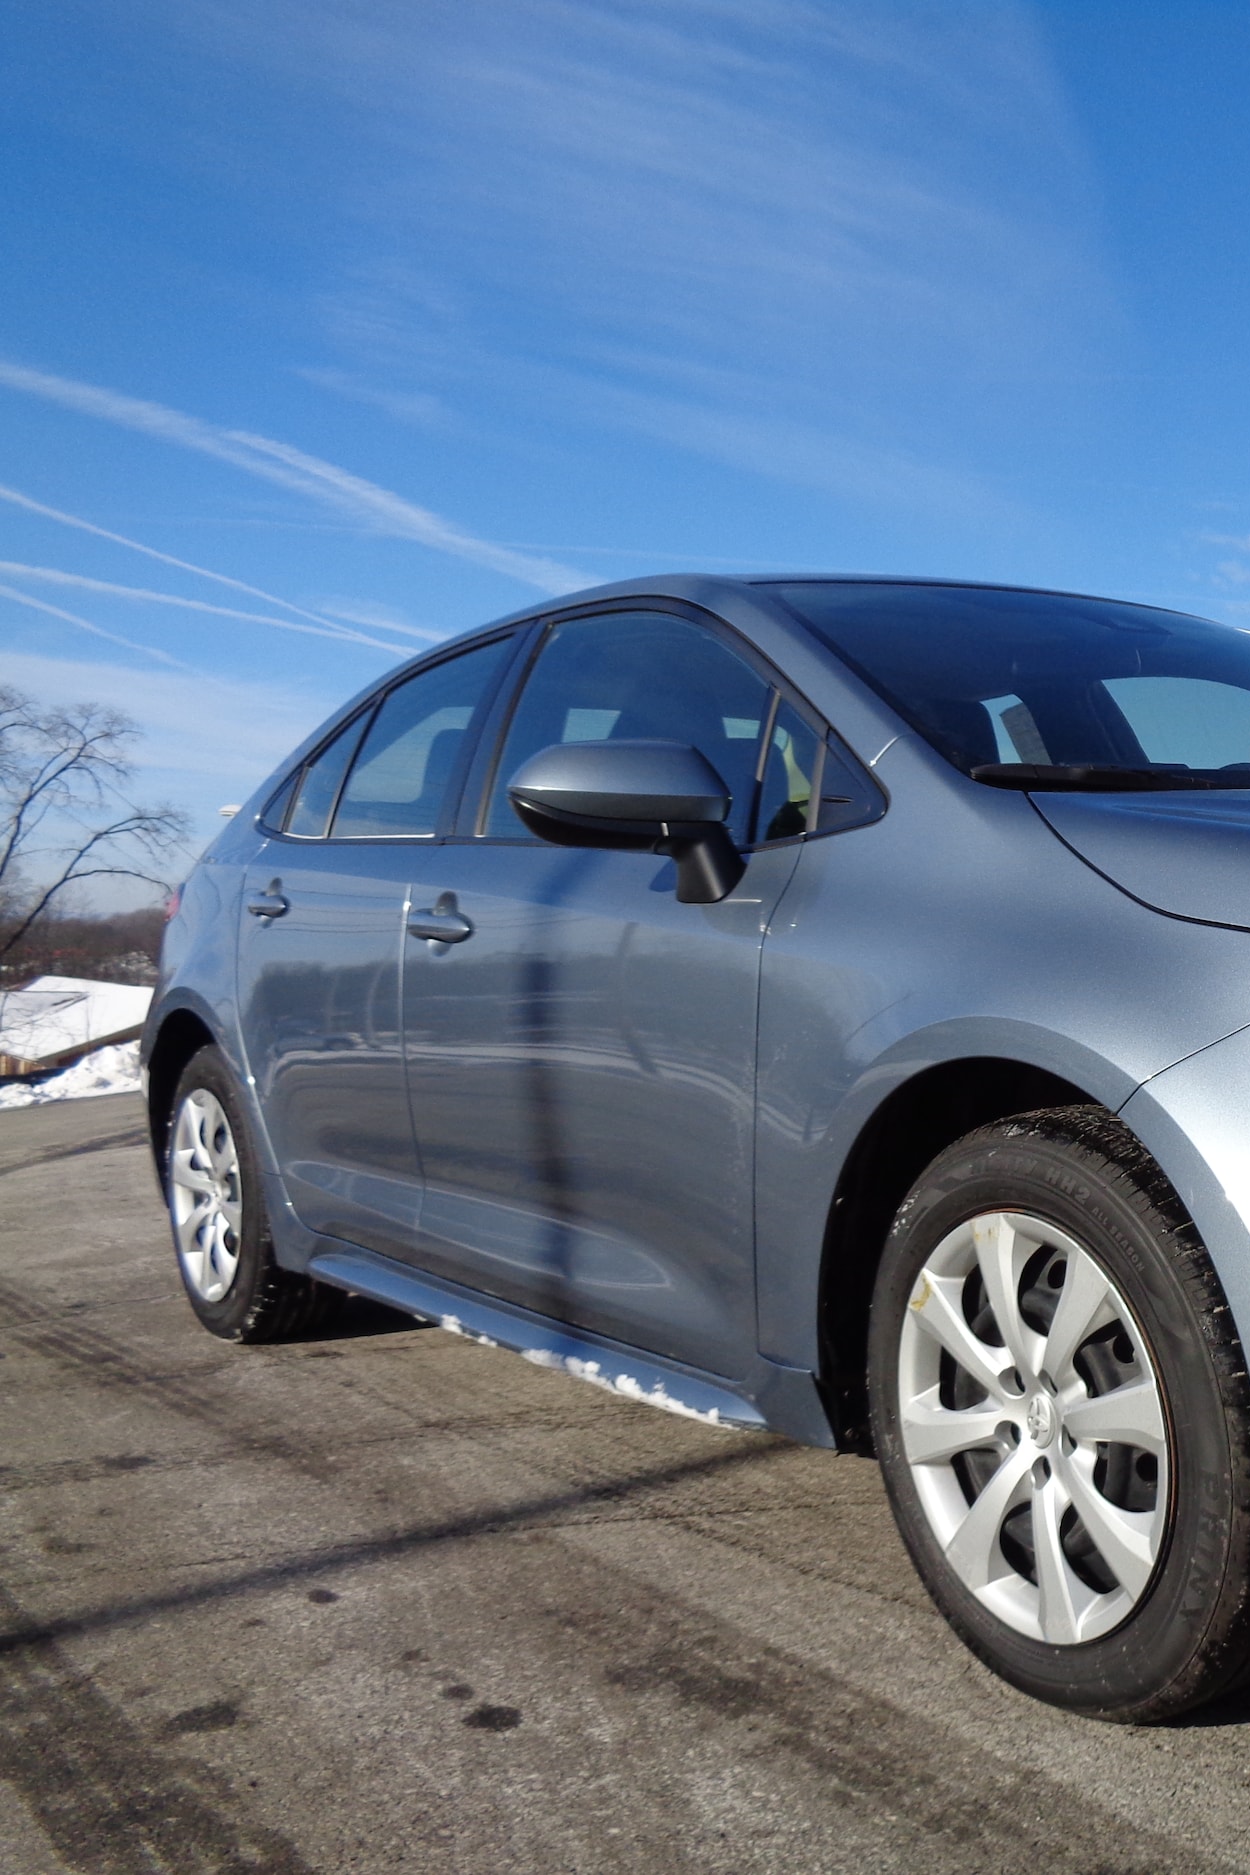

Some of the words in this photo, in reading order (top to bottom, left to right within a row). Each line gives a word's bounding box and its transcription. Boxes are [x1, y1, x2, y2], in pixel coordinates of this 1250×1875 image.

[1044, 1166, 1091, 1205] HH2
[1092, 1207, 1109, 1226] ALL
[1108, 1226, 1145, 1272] SEASON
